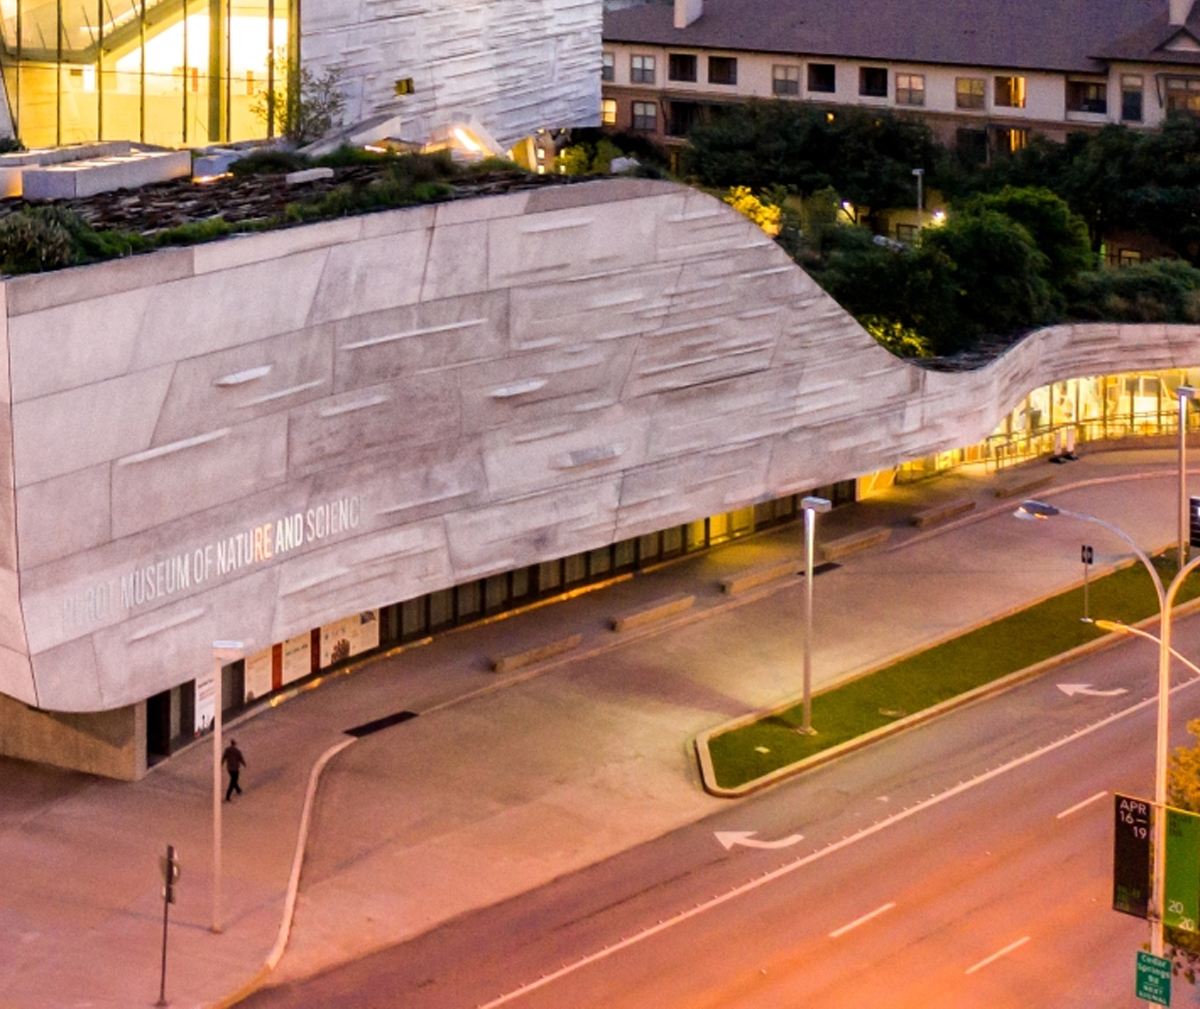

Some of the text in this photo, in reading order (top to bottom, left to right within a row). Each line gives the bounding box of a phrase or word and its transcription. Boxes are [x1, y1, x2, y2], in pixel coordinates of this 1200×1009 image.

[121, 553, 190, 609] MUSEUM
[194, 545, 213, 584] OF
[217, 522, 273, 575] NATURE
[275, 513, 303, 554] AND
[306, 495, 362, 541] SCIENC
[1120, 799, 1147, 815] APR
[1133, 826, 1147, 839] 19
[1168, 899, 1184, 914] 20
[1179, 916, 1195, 932] 20
